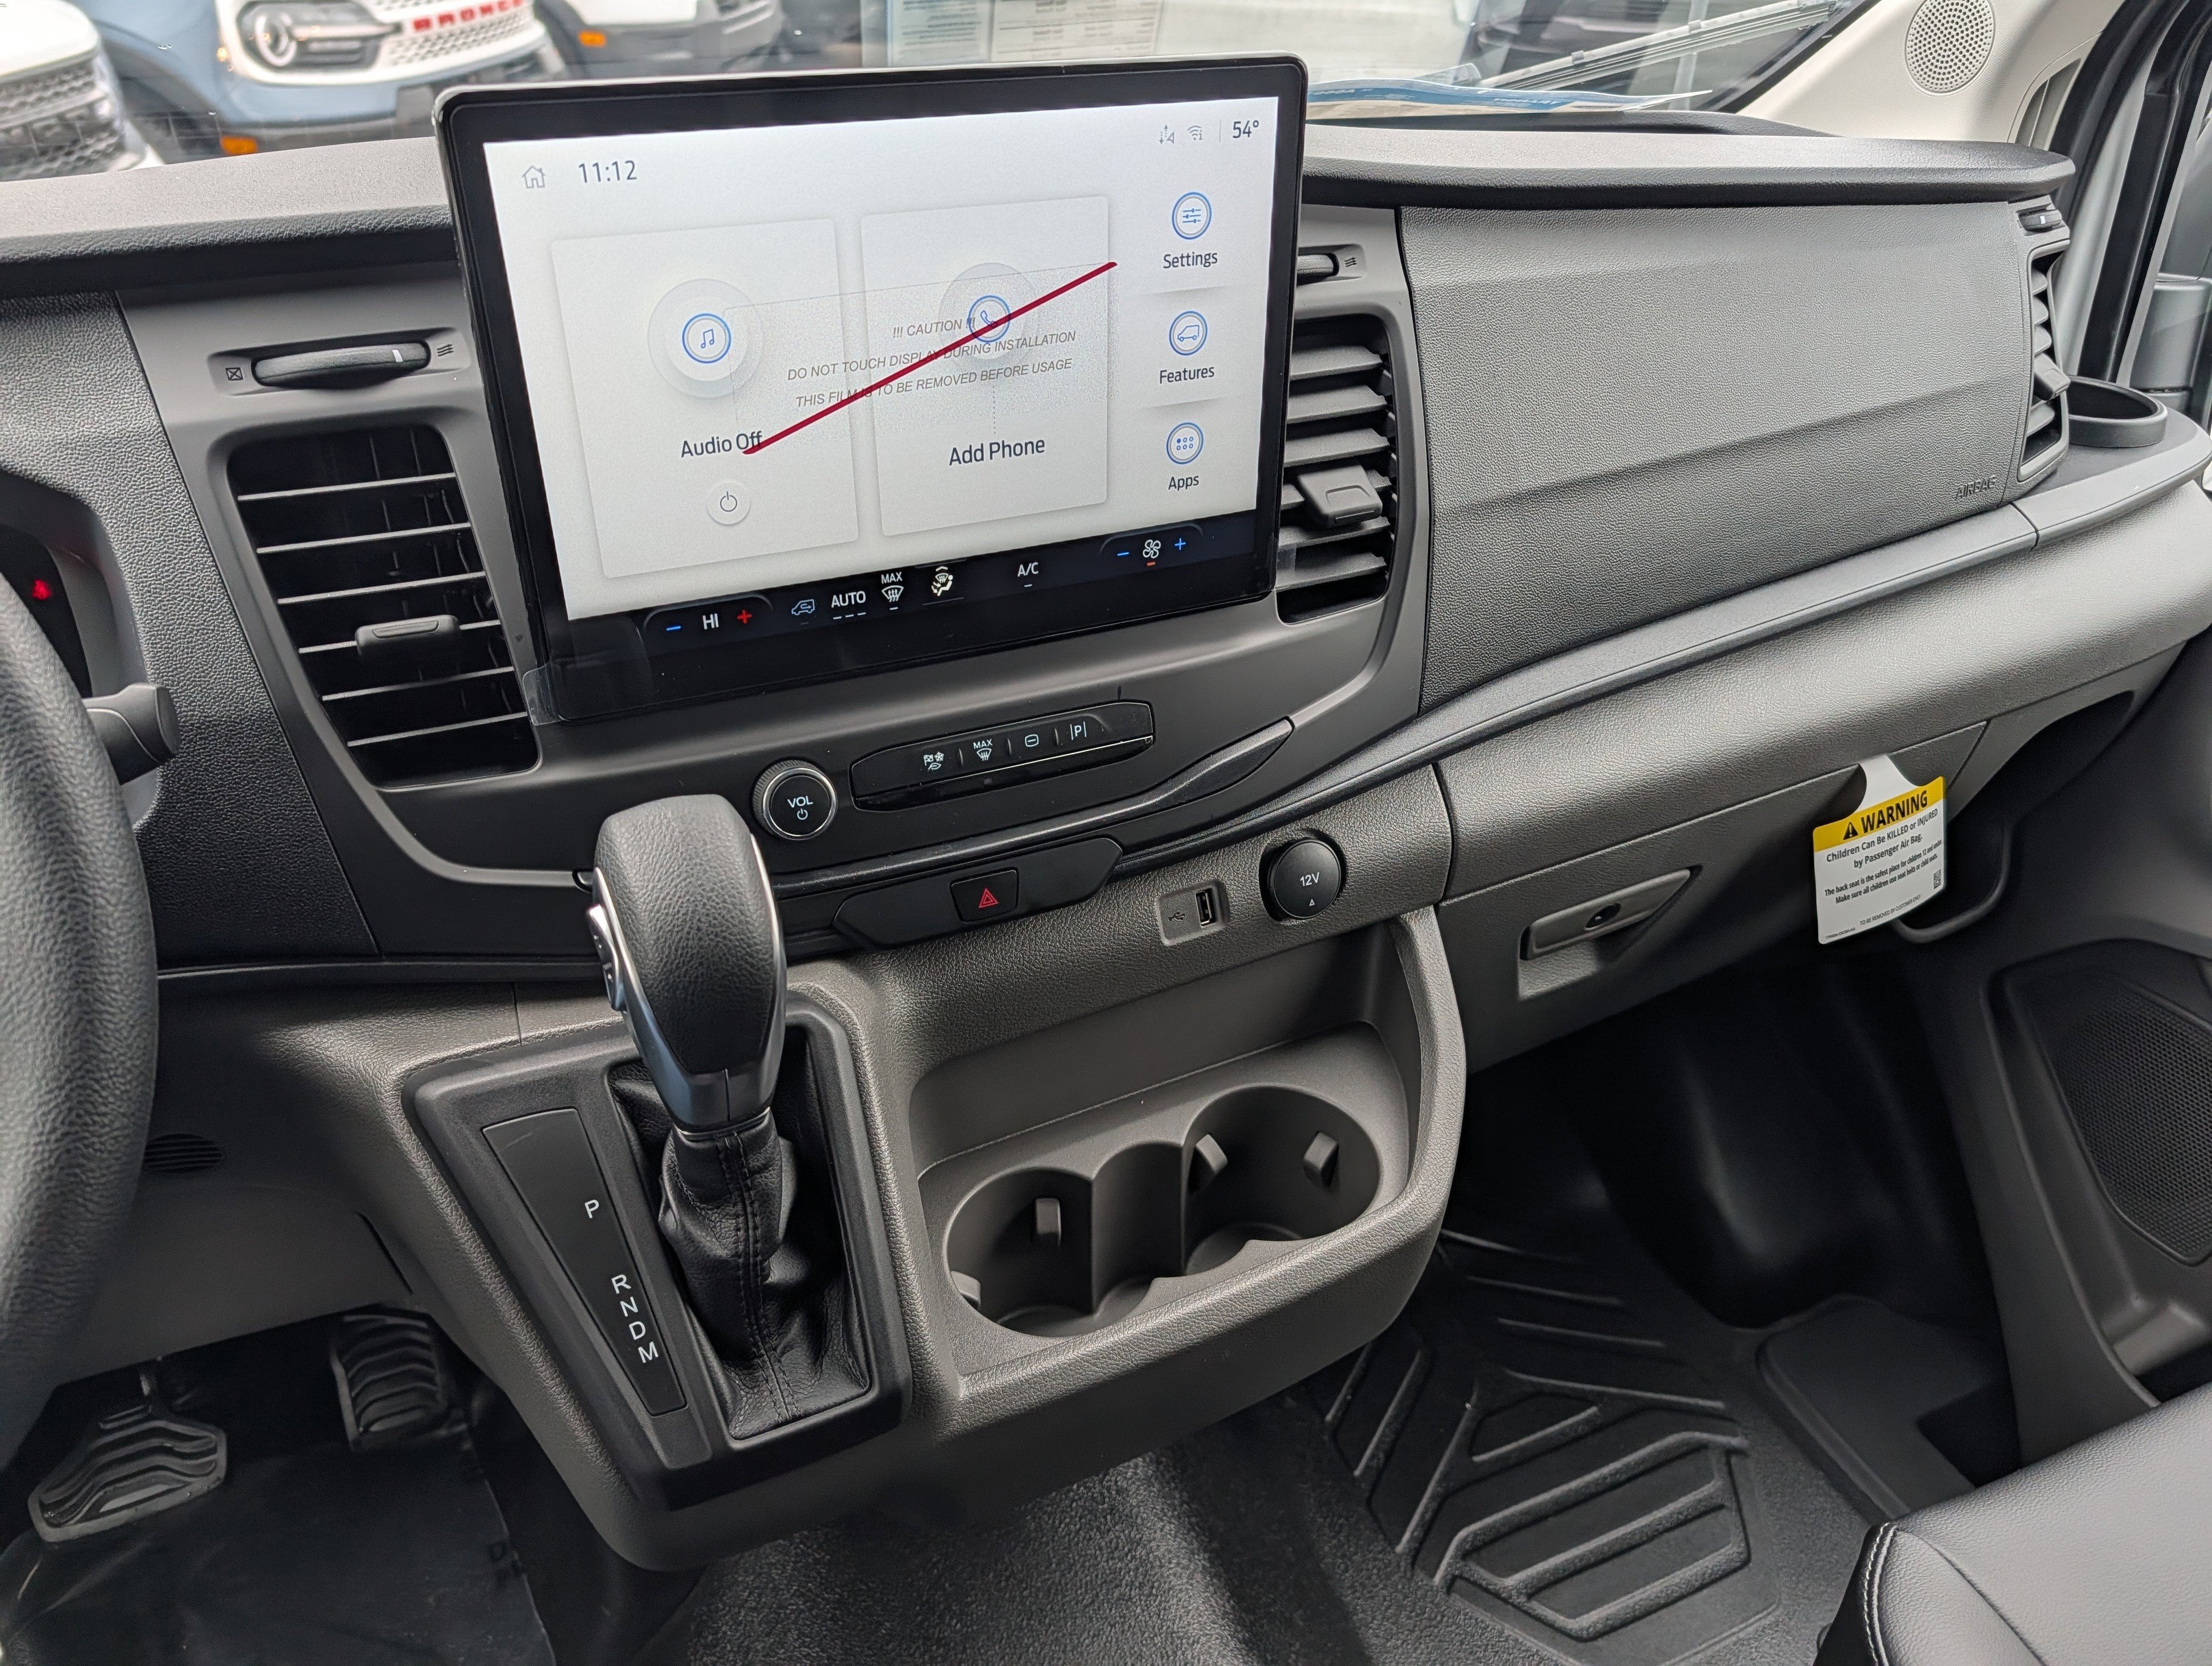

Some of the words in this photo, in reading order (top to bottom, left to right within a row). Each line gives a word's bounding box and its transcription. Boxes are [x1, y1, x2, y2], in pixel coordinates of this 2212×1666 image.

[1232, 119, 1259, 139] 54°
[578, 160, 638, 184] 11:12
[1163, 252, 1218, 268] Settings
[906, 319, 962, 336] CAUTION
[788, 368, 807, 380] DO
[811, 363, 838, 377] NOT
[842, 356, 886, 373] TOUCH
[944, 343, 991, 359] DURING
[994, 331, 1076, 353] INSTALLATION
[796, 393, 825, 407] THIS
[896, 381, 913, 394] BE
[916, 373, 976, 390] REMOVED
[980, 364, 1029, 381] BEFORE
[1032, 358, 1073, 374] USAGE
[1159, 367, 1215, 384] Features
[681, 436, 732, 458] Audio
[736, 431, 763, 450] Off
[949, 443, 984, 466] Add
[989, 438, 1046, 460] Phone
[1168, 475, 1199, 491] Apps
[1955, 477, 1996, 499] AIRBAG
[881, 572, 903, 584] MAX
[1017, 562, 1039, 578] A/C
[831, 591, 866, 609] AUTO
[702, 613, 719, 630] HI
[973, 738, 993, 749] MAX
[787, 796, 813, 808] VOL
[1861, 790, 1927, 834] WARNING
[1826, 846, 1860, 862] Children
[1861, 840, 1875, 850] Can
[1876, 836, 1885, 845] Be
[1887, 825, 1908, 841] KILLED
[1909, 822, 1916, 830] or
[1917, 808, 1938, 826] INJURED
[1854, 859, 1863, 868] by
[1864, 844, 1899, 864] Passenger
[1900, 839, 1909, 849] Air
[1911, 834, 1922, 844] Bag.
[1300, 872, 1320, 887] 12V
[1824, 888, 1835, 896] The
[1836, 883, 1848, 893] back
[1849, 880, 1860, 888] seat
[1875, 868, 1888, 879] safest
[1889, 863, 1900, 875] place
[1907, 853, 1922, 864] children
[1835, 894, 1850, 904] Make
[1851, 890, 1862, 899] sure
[1870, 880, 1888, 892] children
[1897, 871, 1906, 880] seat
[1906, 866, 1915, 875] belts
[1872, 909, 1890, 921] REMOVED
[1895, 898, 1913, 912] CUSTOMER
[1913, 894, 1921, 902] ONLY
[584, 1199, 600, 1219] P
[611, 1274, 632, 1295] R
[620, 1296, 639, 1317] N
[628, 1321, 646, 1341] D
[638, 1341, 659, 1363] M
